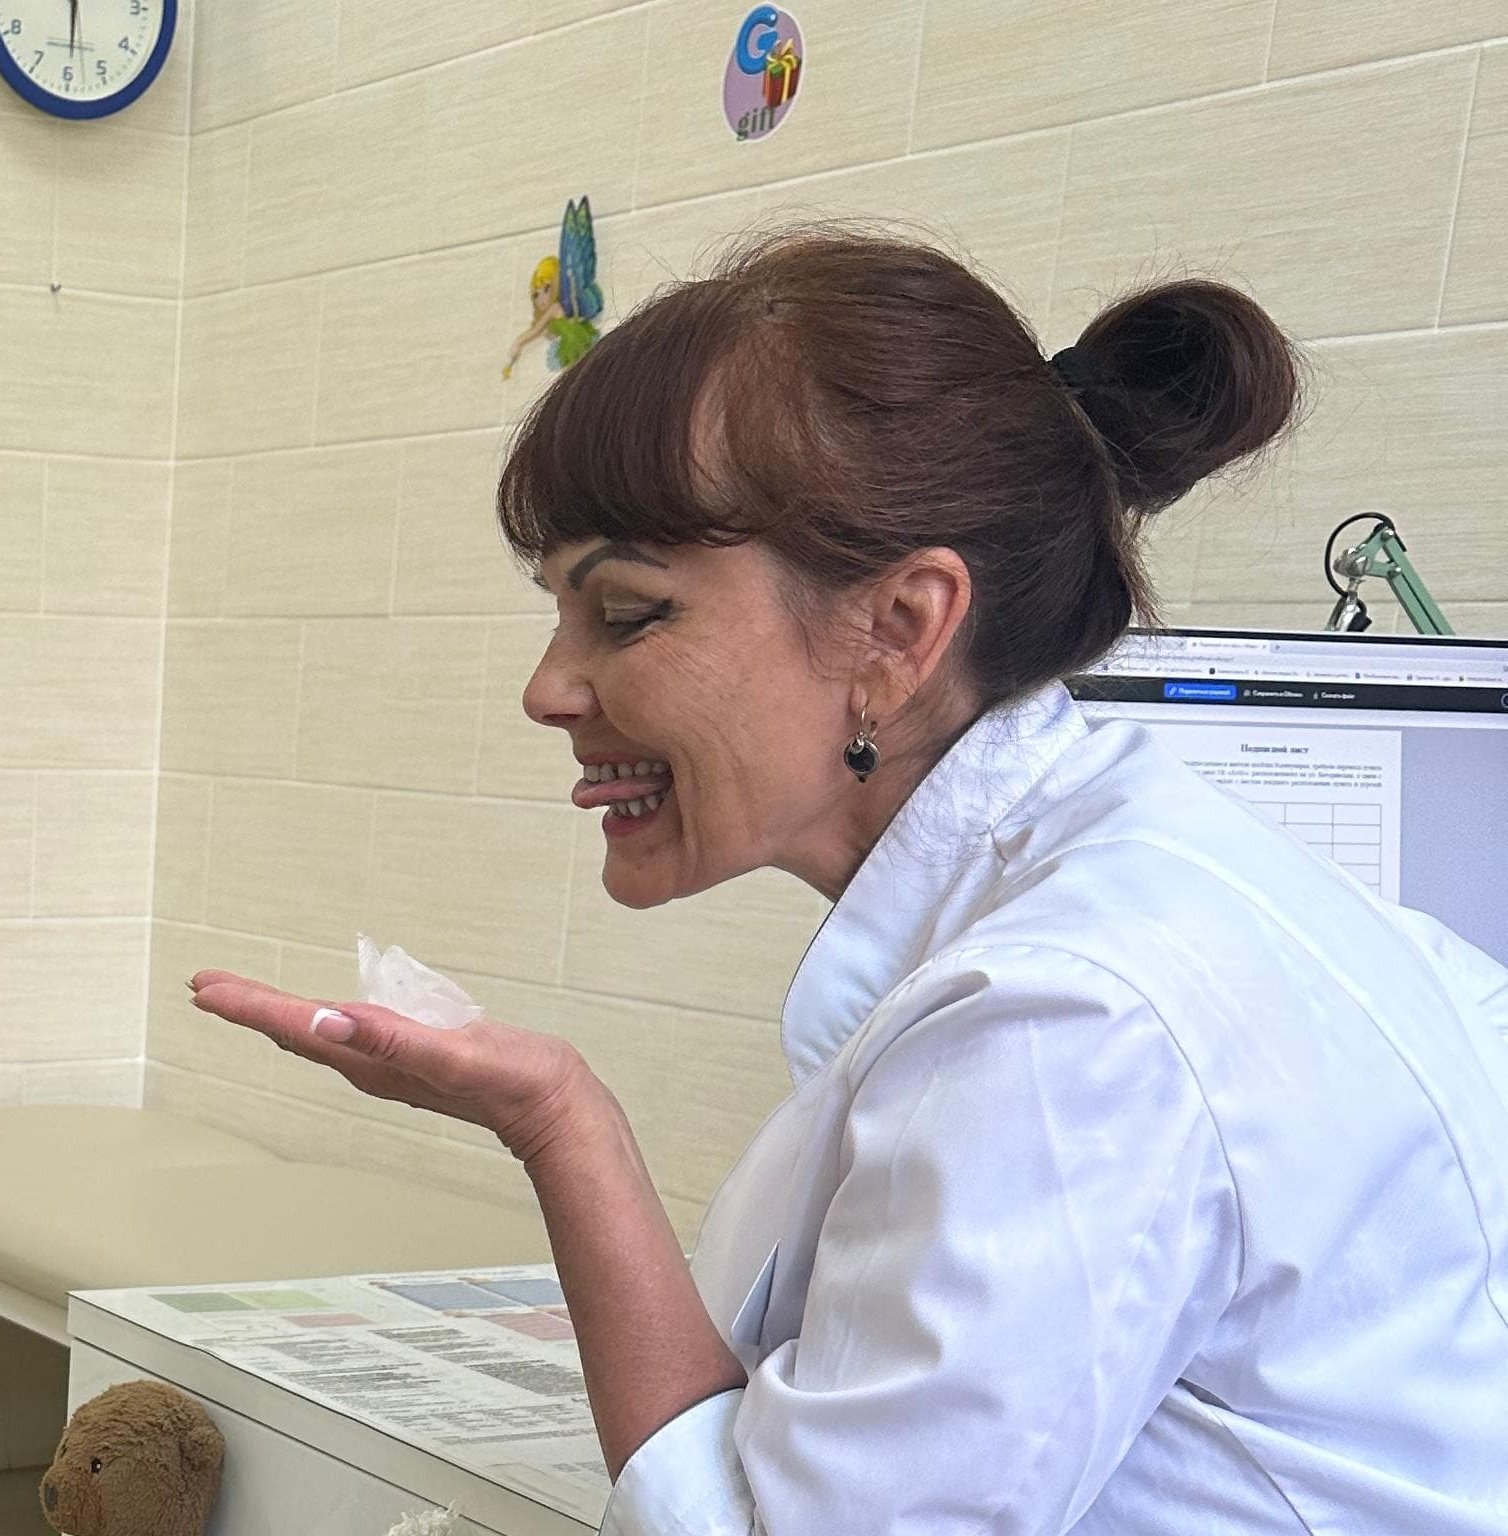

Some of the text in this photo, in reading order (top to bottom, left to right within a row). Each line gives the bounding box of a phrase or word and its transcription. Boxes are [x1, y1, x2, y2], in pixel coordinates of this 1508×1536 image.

[129, 0, 141, 15] 3
[11, 19, 22, 35] 8
[118, 37, 129, 51] 4
[34, 51, 45, 66] 7
[62, 66, 73, 81] 6
[96, 60, 107, 75] 5
[737, 107, 776, 142] gift
